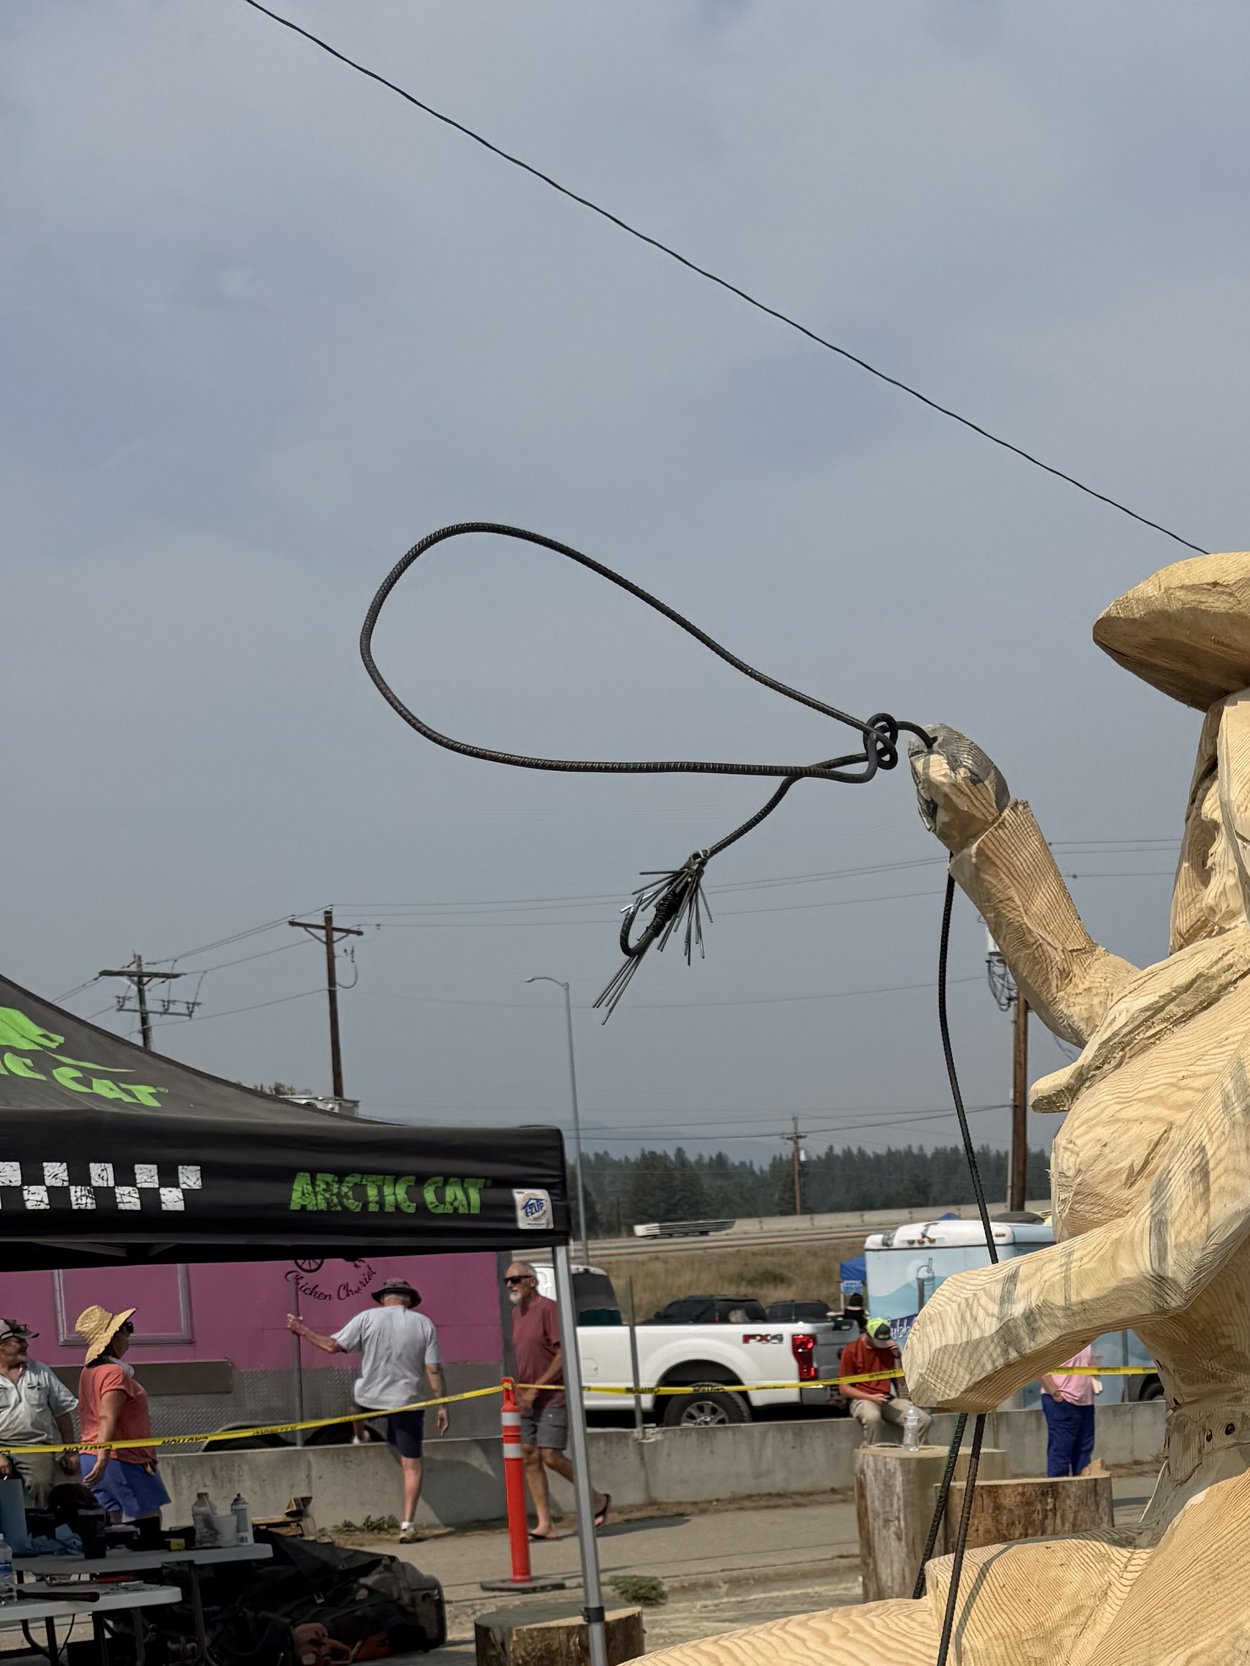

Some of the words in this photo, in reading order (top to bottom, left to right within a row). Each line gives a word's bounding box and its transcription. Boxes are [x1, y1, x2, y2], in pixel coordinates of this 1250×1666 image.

[52, 1066, 162, 1107] CAT
[290, 1172, 417, 1213] ARCTIC
[423, 1175, 486, 1214] CAT
